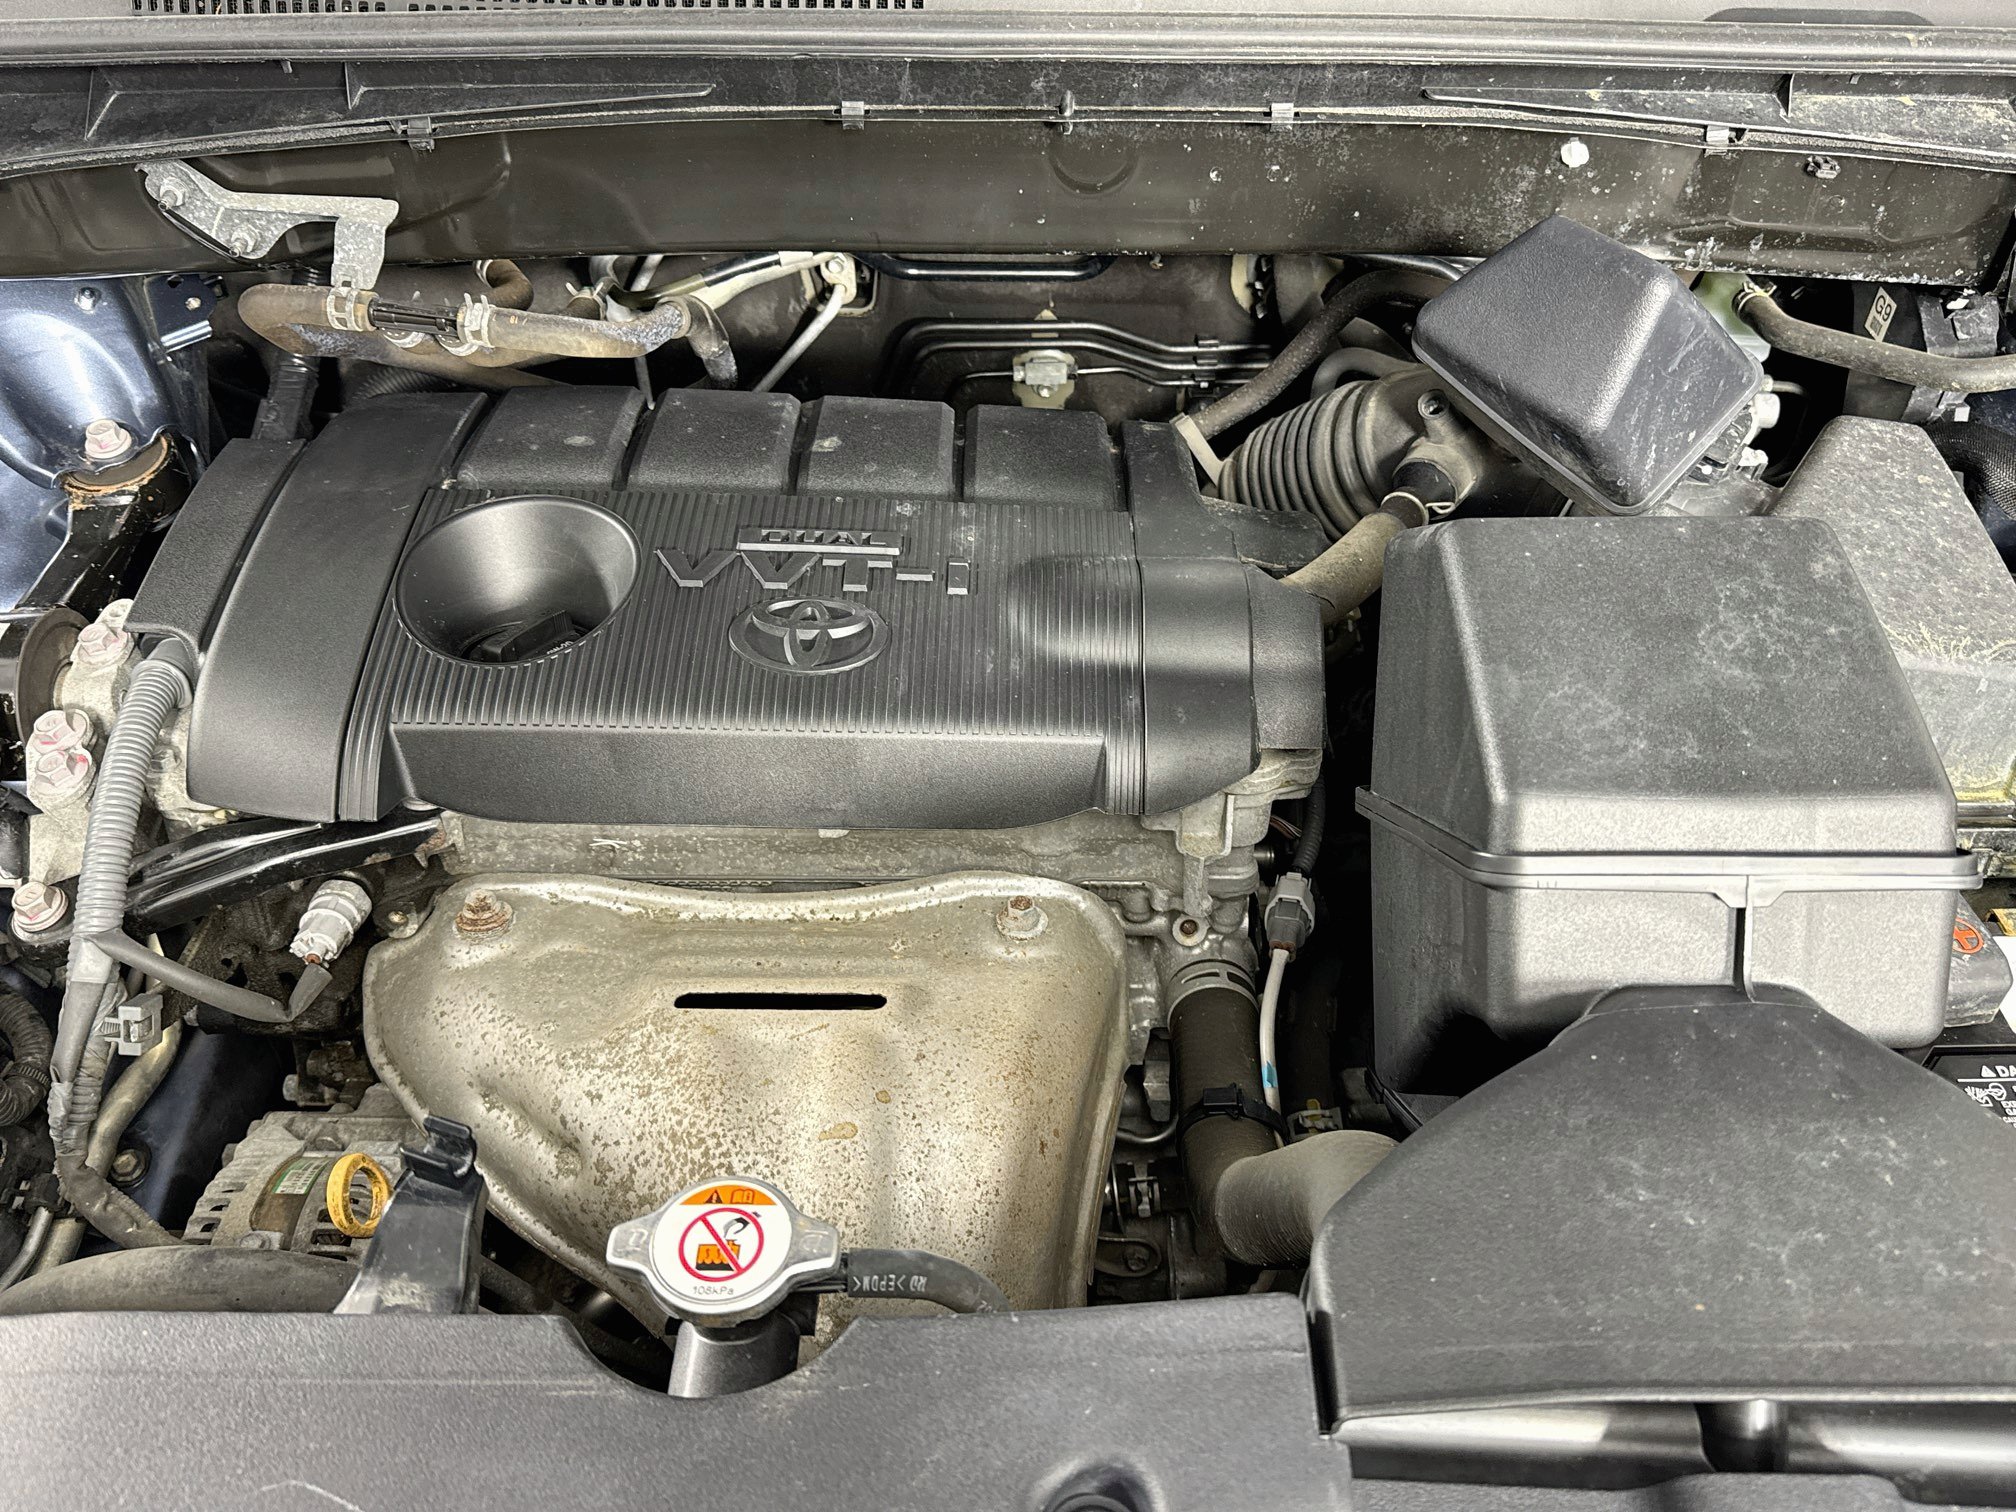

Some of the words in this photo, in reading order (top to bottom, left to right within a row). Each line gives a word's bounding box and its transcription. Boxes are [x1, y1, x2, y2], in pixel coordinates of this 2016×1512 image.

[1875, 295, 1892, 322] G9
[761, 528, 888, 545] DUAL
[692, 1285, 734, 1296] 108kPa
